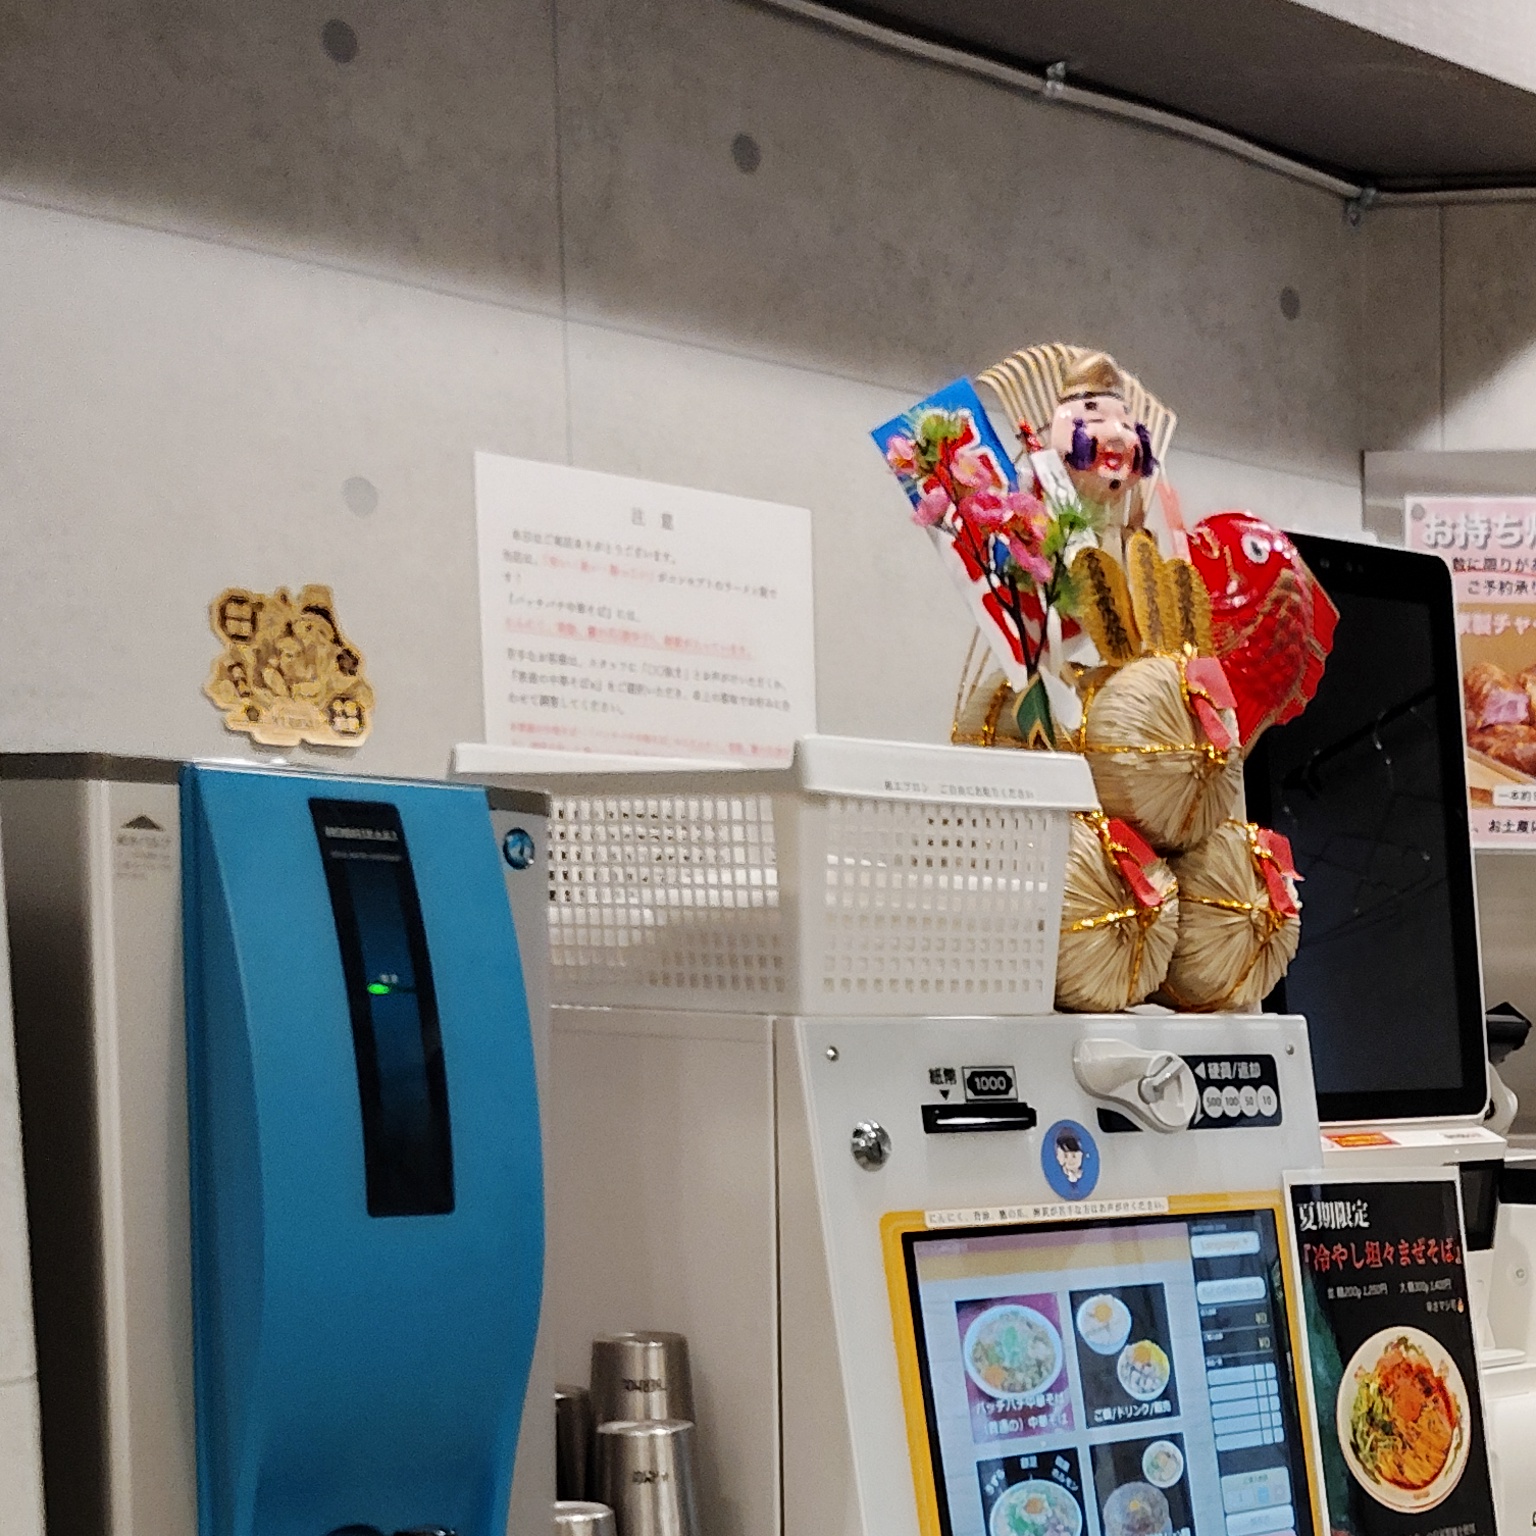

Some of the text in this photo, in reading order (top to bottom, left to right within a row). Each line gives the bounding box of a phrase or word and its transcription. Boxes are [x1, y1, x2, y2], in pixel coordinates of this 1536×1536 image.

[974, 1076, 1006, 1091] 1000
[1225, 1096, 1240, 1107] 100
[1262, 1095, 1272, 1106] 10
